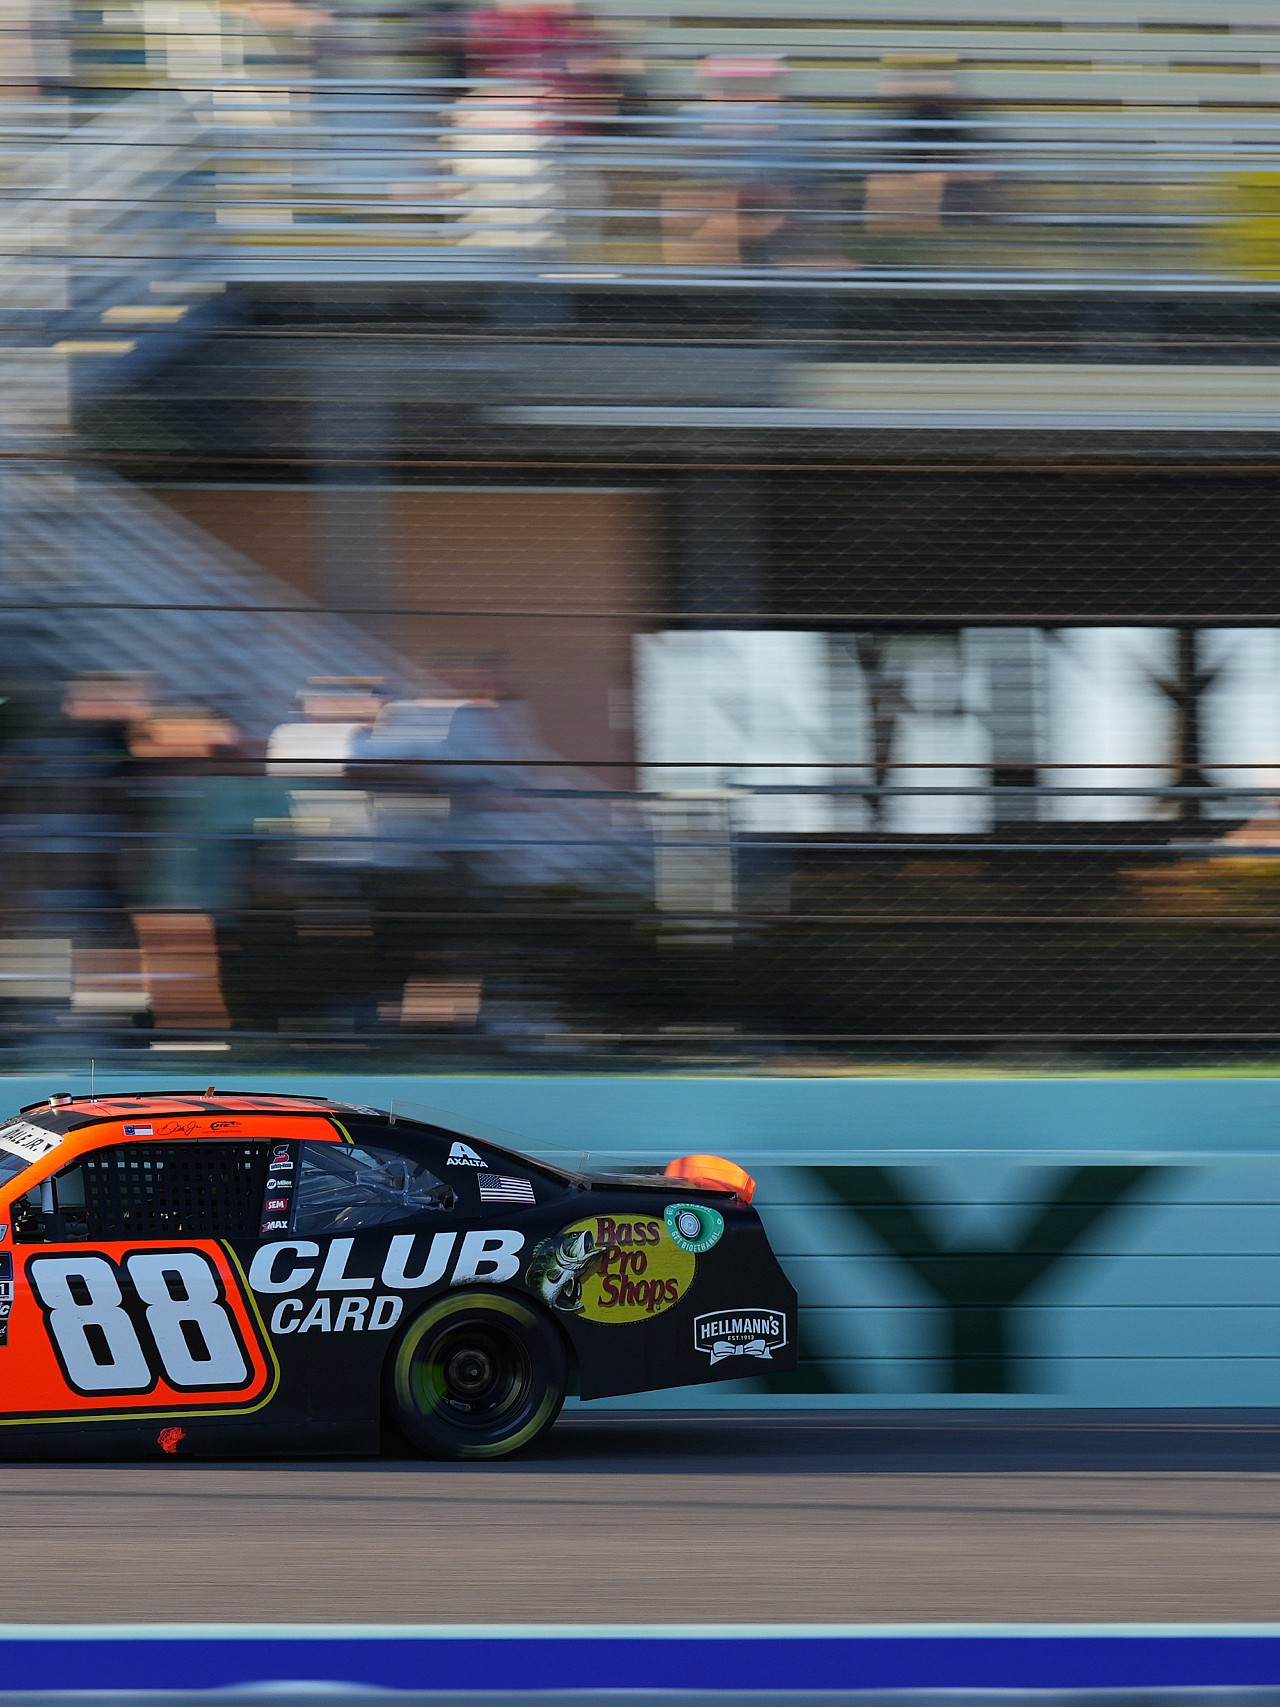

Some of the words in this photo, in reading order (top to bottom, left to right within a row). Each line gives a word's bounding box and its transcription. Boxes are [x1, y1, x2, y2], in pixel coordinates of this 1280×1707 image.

[2, 1129, 33, 1145] DALE
[446, 1158, 489, 1168] AXALTA
[268, 1200, 284, 1209] SEM
[595, 1217, 660, 1246] Bass
[671, 1231, 683, 1244] GET
[681, 1230, 721, 1252] BIOETHANOL
[248, 1229, 526, 1294] CLUB
[598, 1245, 648, 1277] Pro
[598, 1274, 679, 1313] Shops
[30, 1252, 248, 1391] 88
[270, 1295, 404, 1335] CARD
[701, 1315, 780, 1339] HELLMANN'S
